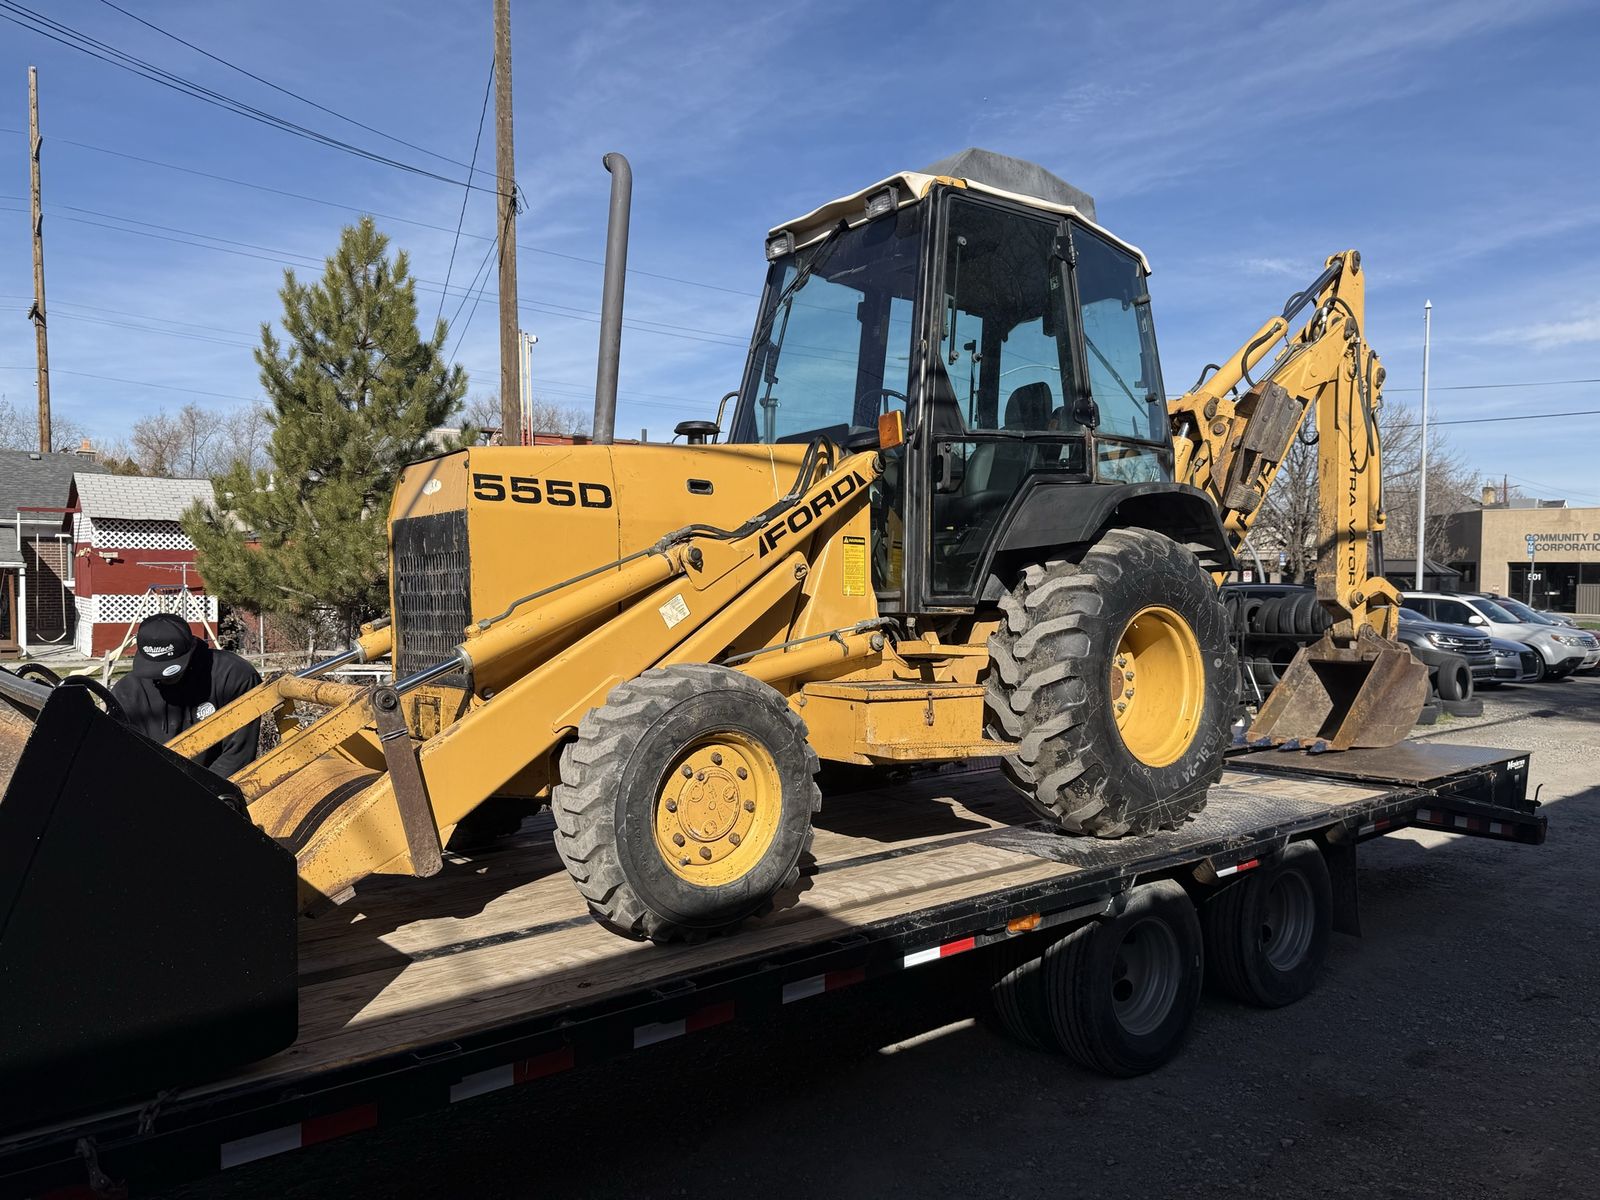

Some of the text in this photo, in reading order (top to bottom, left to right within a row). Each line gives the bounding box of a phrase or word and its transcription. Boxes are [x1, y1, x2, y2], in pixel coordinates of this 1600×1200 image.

[472, 473, 613, 509] 555D
[763, 474, 857, 551] FORD
[1524, 533, 1589, 542] COMMUNITY
